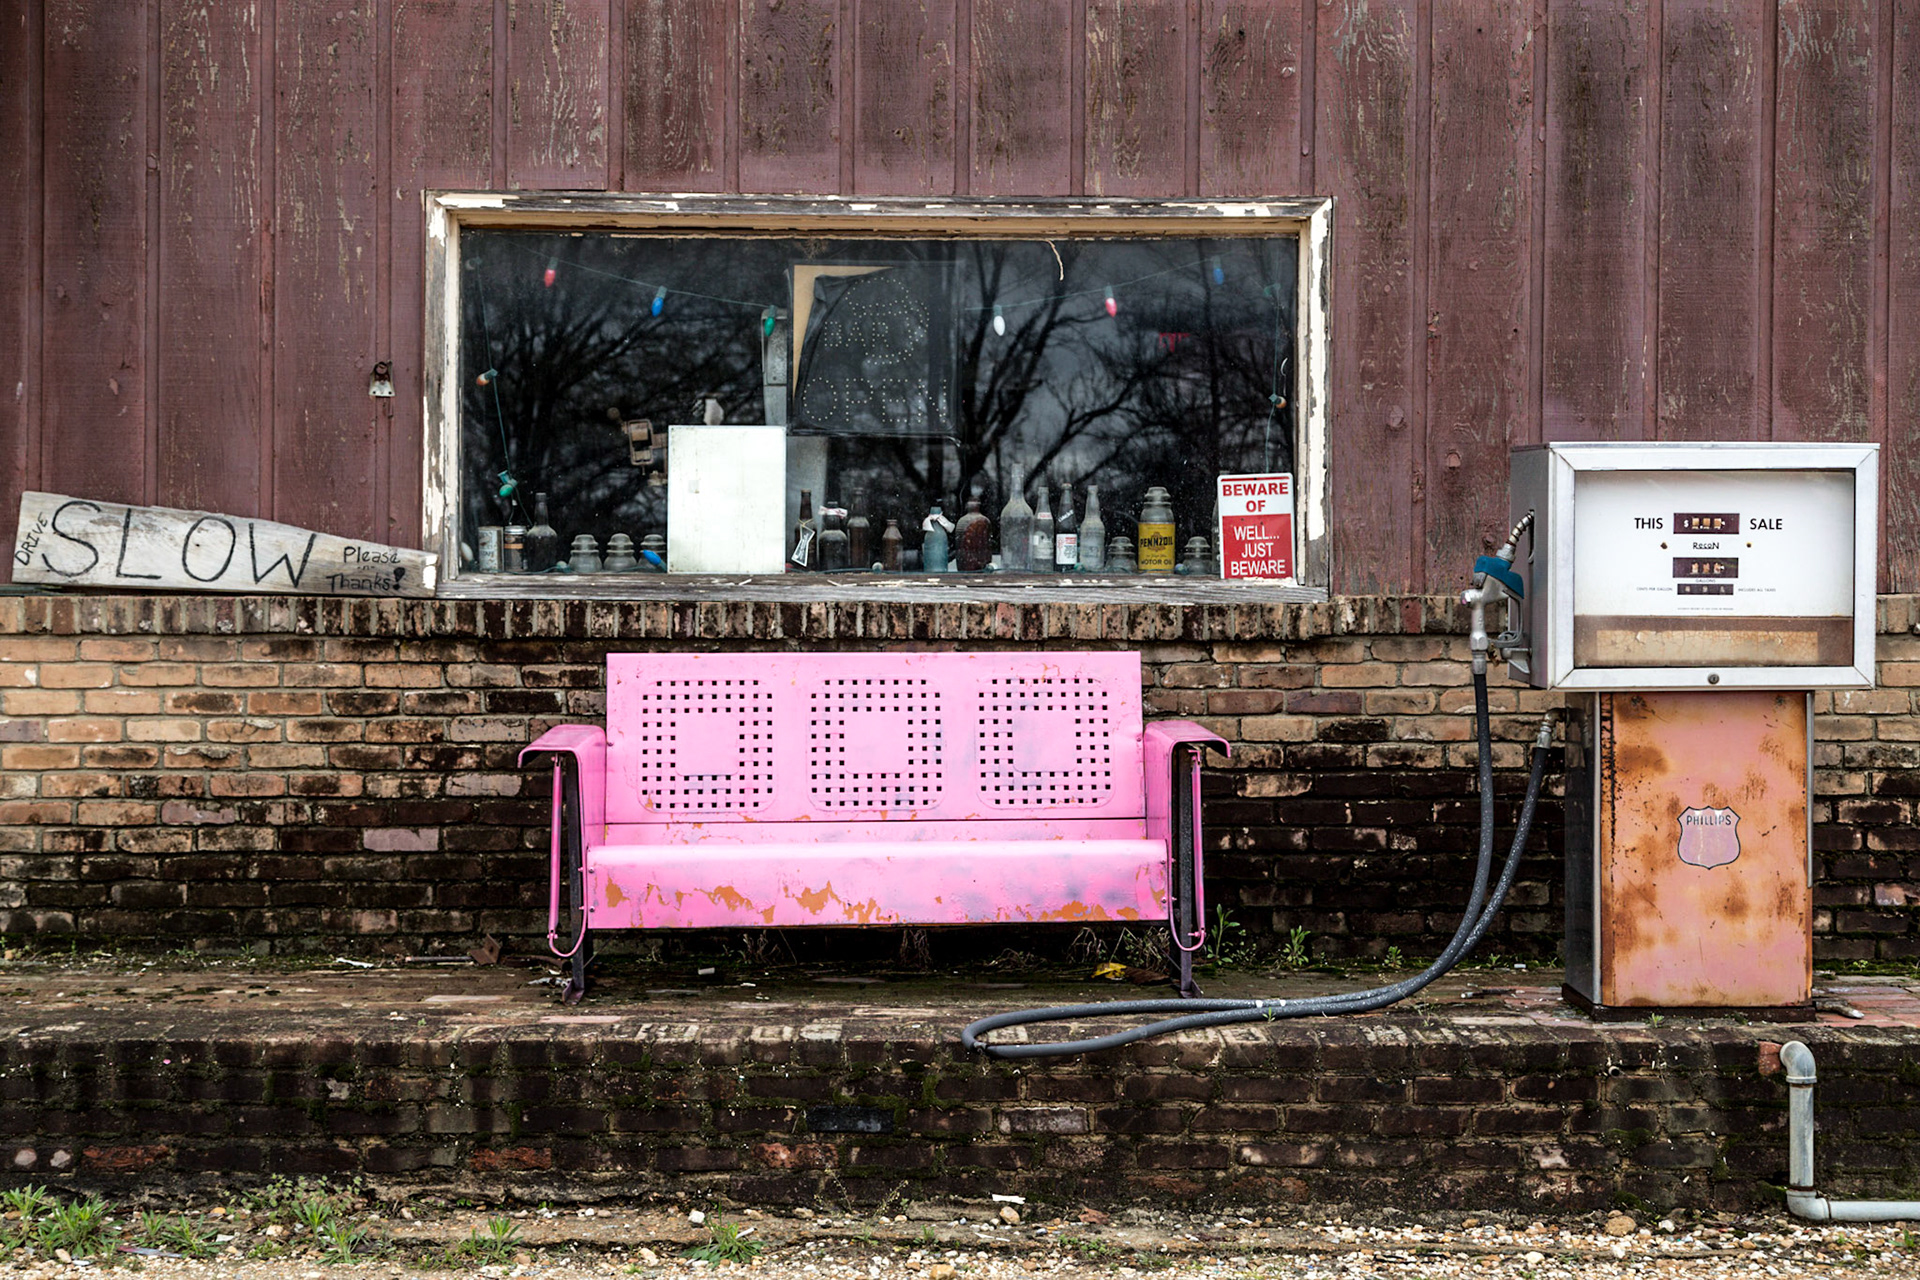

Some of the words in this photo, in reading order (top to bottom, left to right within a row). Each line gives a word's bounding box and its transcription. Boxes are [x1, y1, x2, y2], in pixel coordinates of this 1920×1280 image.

[825, 321, 889, 347] BAR
[803, 377, 947, 423] OPEN
[1222, 482, 1289, 496] BEWARE
[1245, 499, 1266, 512] OF
[1634, 517, 1664, 530] THIS
[1749, 518, 1783, 530] SALE
[14, 511, 49, 566] DRIVE
[1233, 525, 1280, 541] WELL...
[41, 500, 318, 589] SLOW
[1140, 536, 1174, 548] PENNZOIL
[1241, 542, 1274, 558] JUST
[343, 546, 401, 563] Please
[1230, 560, 1286, 576] BEWARE
[326, 567, 406, 592] Thanks!
[1686, 814, 1732, 826] PHILLIPS
